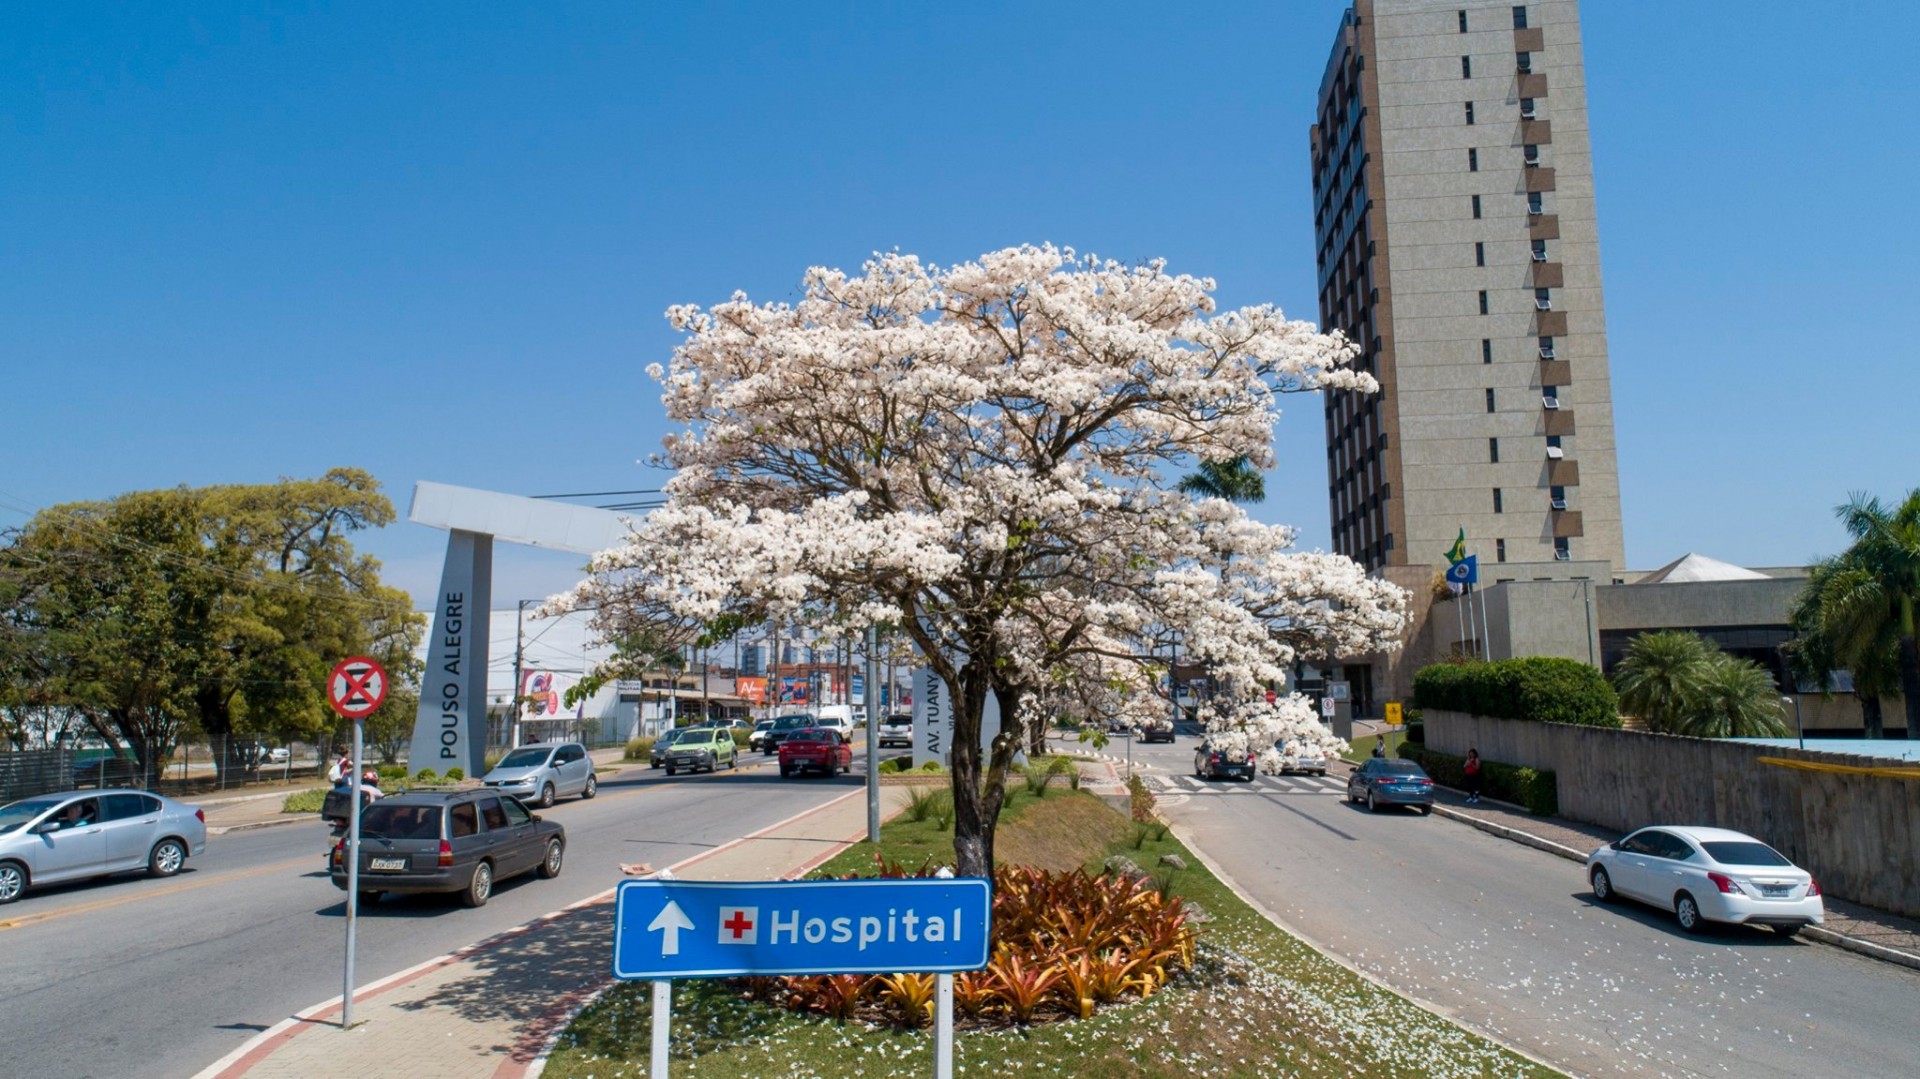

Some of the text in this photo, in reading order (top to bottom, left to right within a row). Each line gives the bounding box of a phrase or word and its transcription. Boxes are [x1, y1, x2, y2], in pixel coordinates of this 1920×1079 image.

[440, 592, 463, 759] POUSO ALEGRE
[927, 674, 940, 726] TUANY
[927, 730, 940, 754] AV.
[770, 907, 961, 951] Hospital
